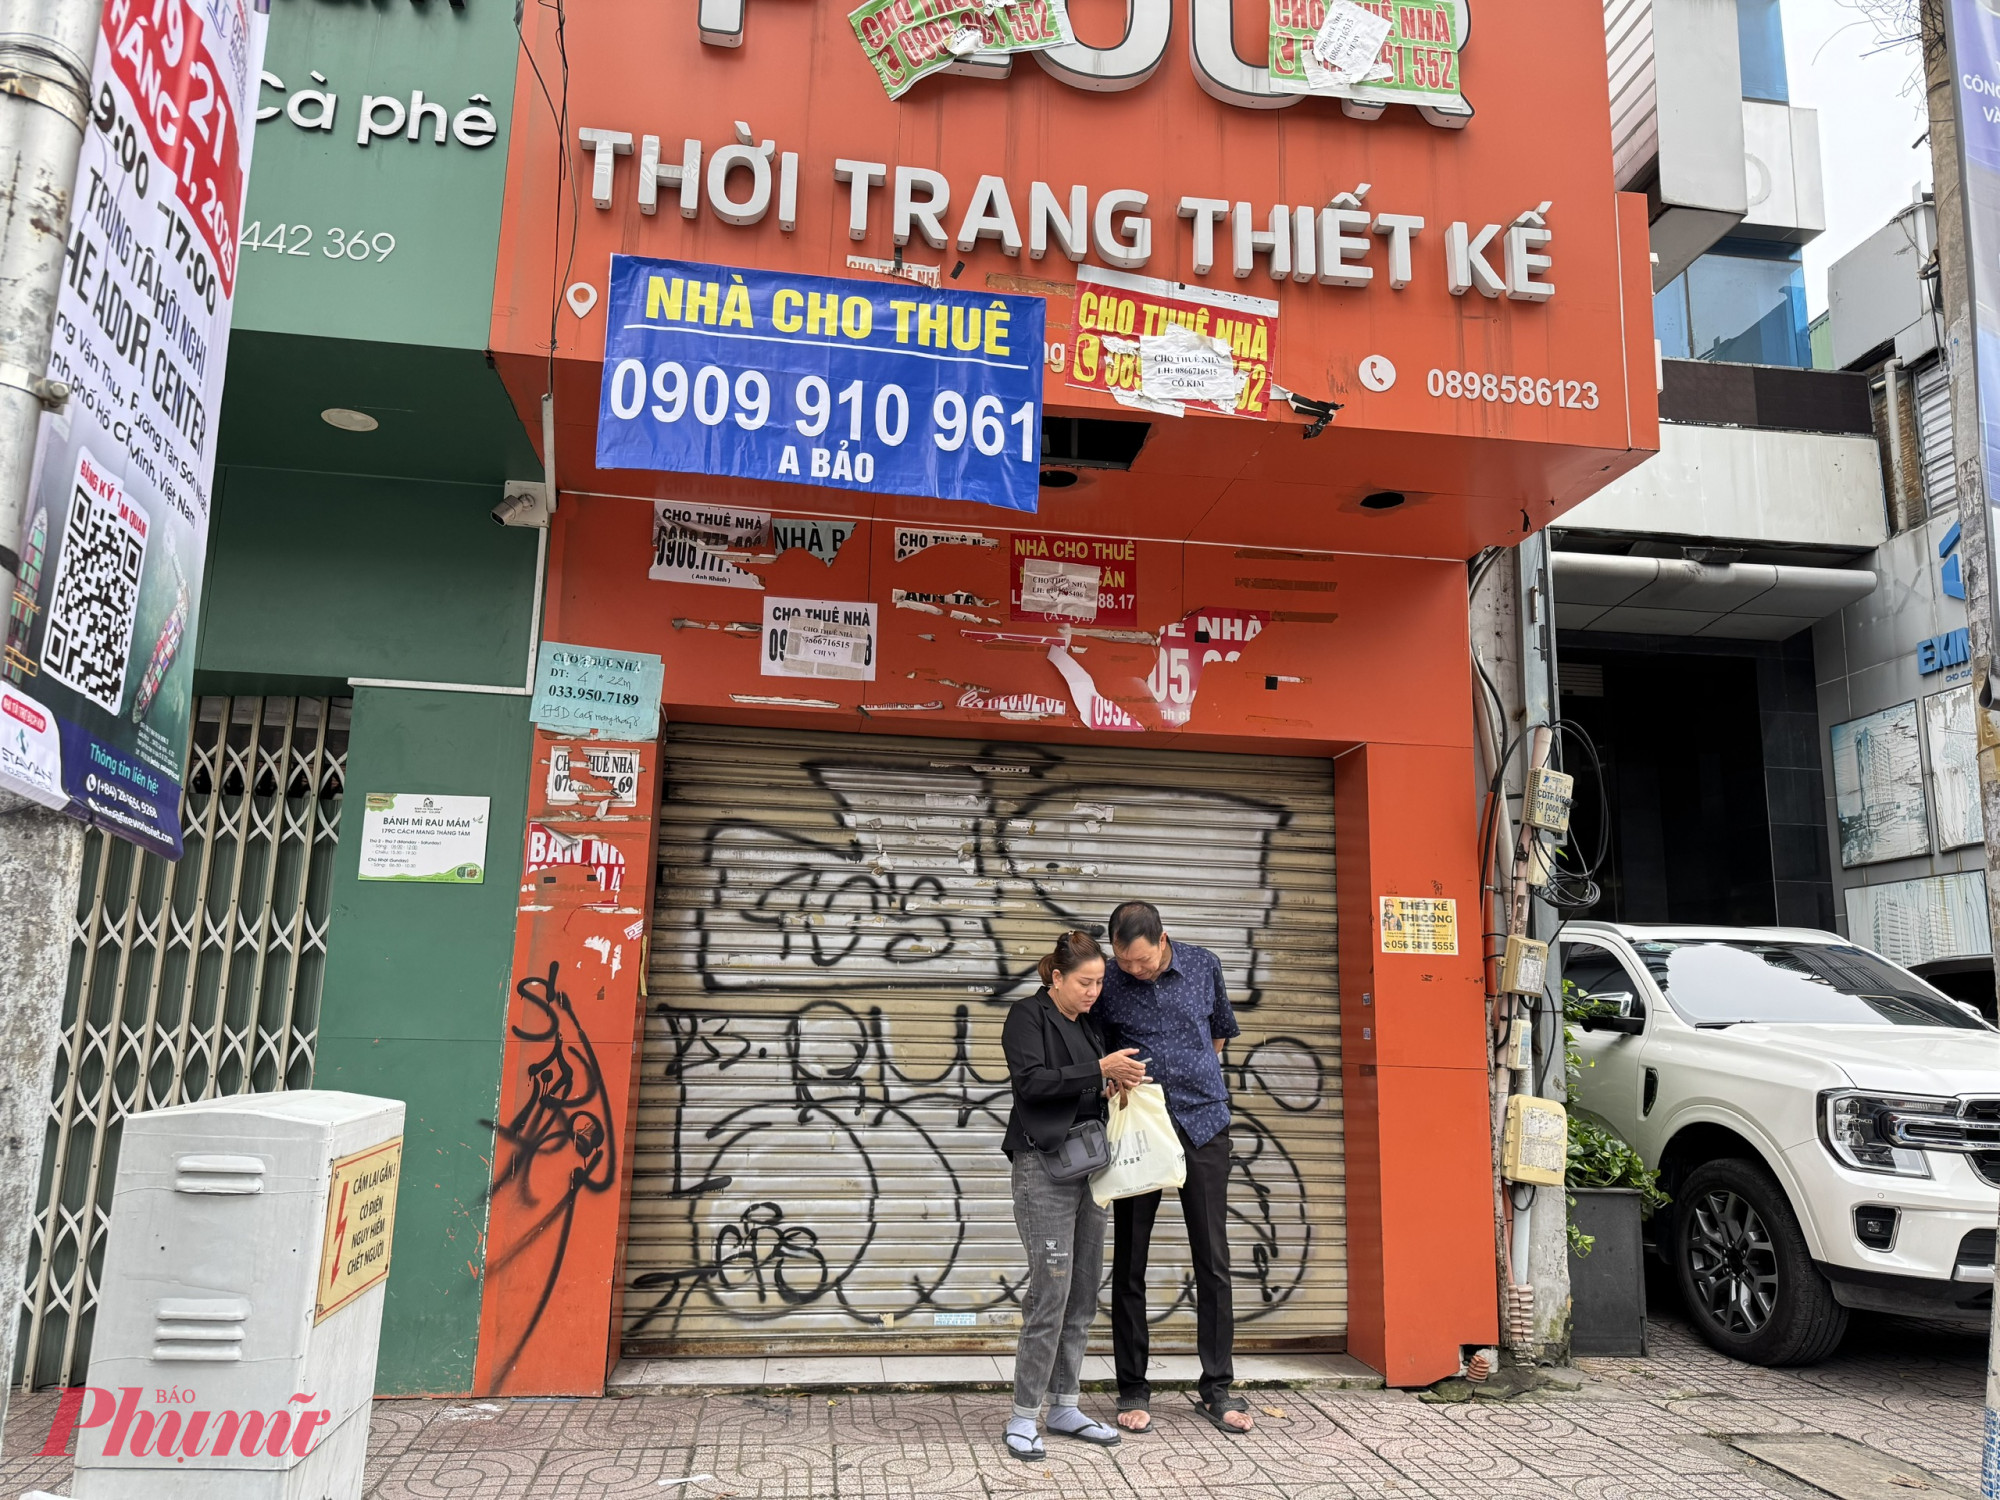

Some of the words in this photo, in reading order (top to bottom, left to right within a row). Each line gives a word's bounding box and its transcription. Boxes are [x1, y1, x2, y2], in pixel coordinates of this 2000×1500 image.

[860, 0, 915, 49] CHO
[1003, 2, 1054, 42] 552
[1400, 5, 1451, 43] NHÀ
[1412, 45, 1455, 89] 552
[188, 61, 227, 167] 21
[357, 90, 497, 147] phê
[201, 177, 234, 283] 2025
[579, 121, 799, 232] THỜI
[834, 158, 1151, 268] TRANG
[1177, 183, 1424, 289] THIẾT
[1444, 201, 1555, 301] KẾ
[87, 166, 132, 267] TRUNG
[154, 281, 181, 341] HỘI
[322, 227, 396, 263] 369
[645, 274, 754, 328] NHÀ
[772, 289, 873, 339] CHO
[895, 300, 1011, 357] THUÊ
[1078, 291, 1136, 335] CHO
[1214, 318, 1268, 362] NHÀ
[65, 222, 97, 305] HE
[92, 268, 151, 386] ADOR
[152, 348, 206, 462] CENTER
[1187, 379, 1205, 389] KIM
[1427, 368, 1600, 410] 0898586123
[610, 358, 771, 432] 0909
[795, 375, 909, 447] 910
[933, 390, 1034, 463] 961
[778, 445, 800, 475] A
[811, 440, 874, 483] BẢO
[662, 508, 692, 522] CHO
[696, 512, 731, 528] THUÊ
[735, 516, 762, 530] NHÀ
[774, 522, 823, 552] NHÀ
[900, 532, 928, 548] CHO
[1015, 536, 1049, 557] NHÀ
[1053, 541, 1089, 558] CHO
[1092, 541, 1135, 561] THUÊ
[1099, 566, 1125, 588] ĂN
[773, 606, 801, 621] CHO
[805, 606, 839, 623] THUÊ
[844, 608, 870, 627] NHÀ
[549, 685, 639, 706] 033.950.7189
[90, 743, 117, 775] Thông
[118, 760, 131, 779] tin
[132, 767, 145, 786] liên
[611, 752, 633, 774] NHÀ
[383, 816, 409, 826] BÁNH
[411, 816, 423, 827] MÌ
[425, 818, 443, 827] RAU
[359, 1200, 368, 1221] CÓ
[351, 1227, 370, 1249] NGUY
